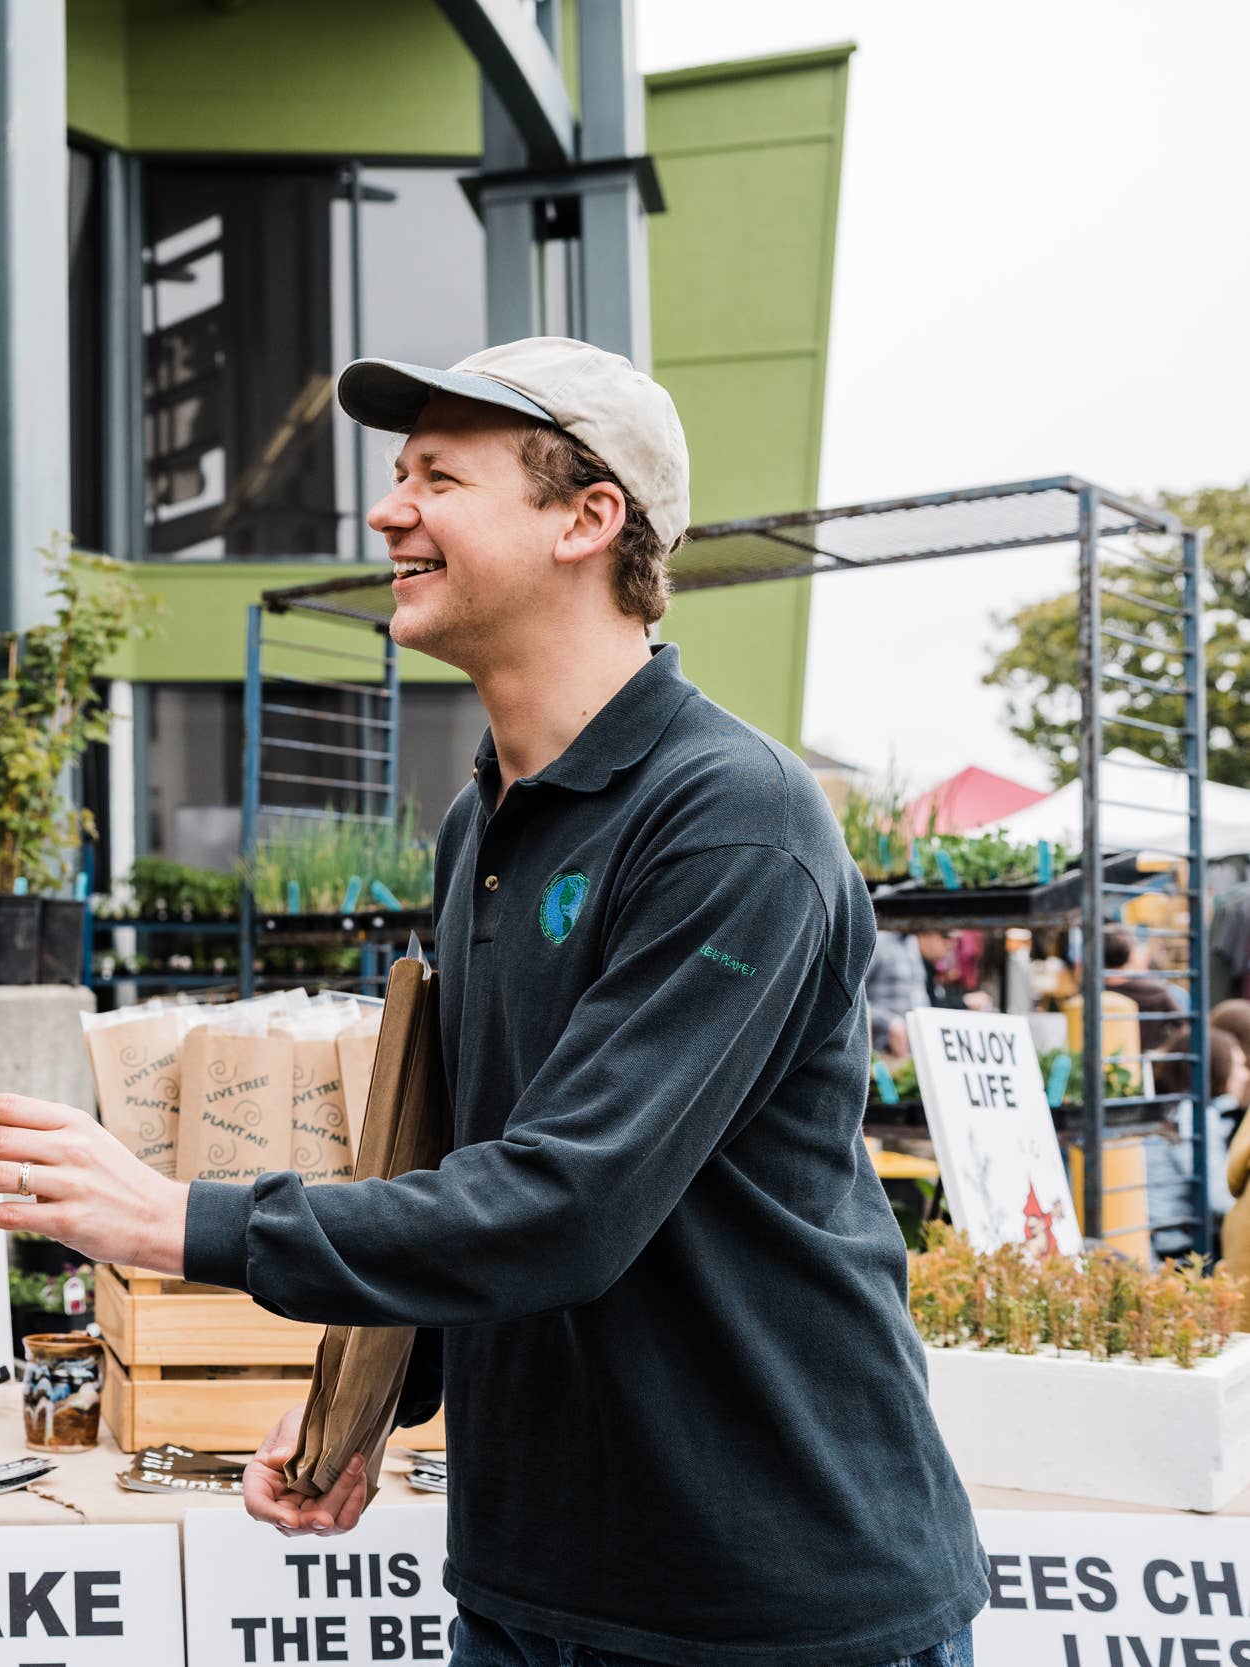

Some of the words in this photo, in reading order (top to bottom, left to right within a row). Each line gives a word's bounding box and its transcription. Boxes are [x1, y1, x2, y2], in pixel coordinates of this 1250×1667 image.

[941, 1028, 1019, 1065] ENJOY
[126, 1095, 168, 1111] PLANT
[206, 1087, 235, 1103] LIVE
[236, 1075, 270, 1093] TREE!
[964, 1073, 1017, 1108] LIFE
[202, 1111, 245, 1137] PLANT
[245, 1132, 269, 1149] ME!
[293, 1119, 328, 1138] LANT
[198, 1168, 240, 1180] GROW
[285, 1553, 421, 1598] THIS
[988, 1555, 1117, 1612] EES
[1143, 1559, 1250, 1617] CH
[231, 1616, 348, 1662] THE
[369, 1615, 459, 1661] BE
